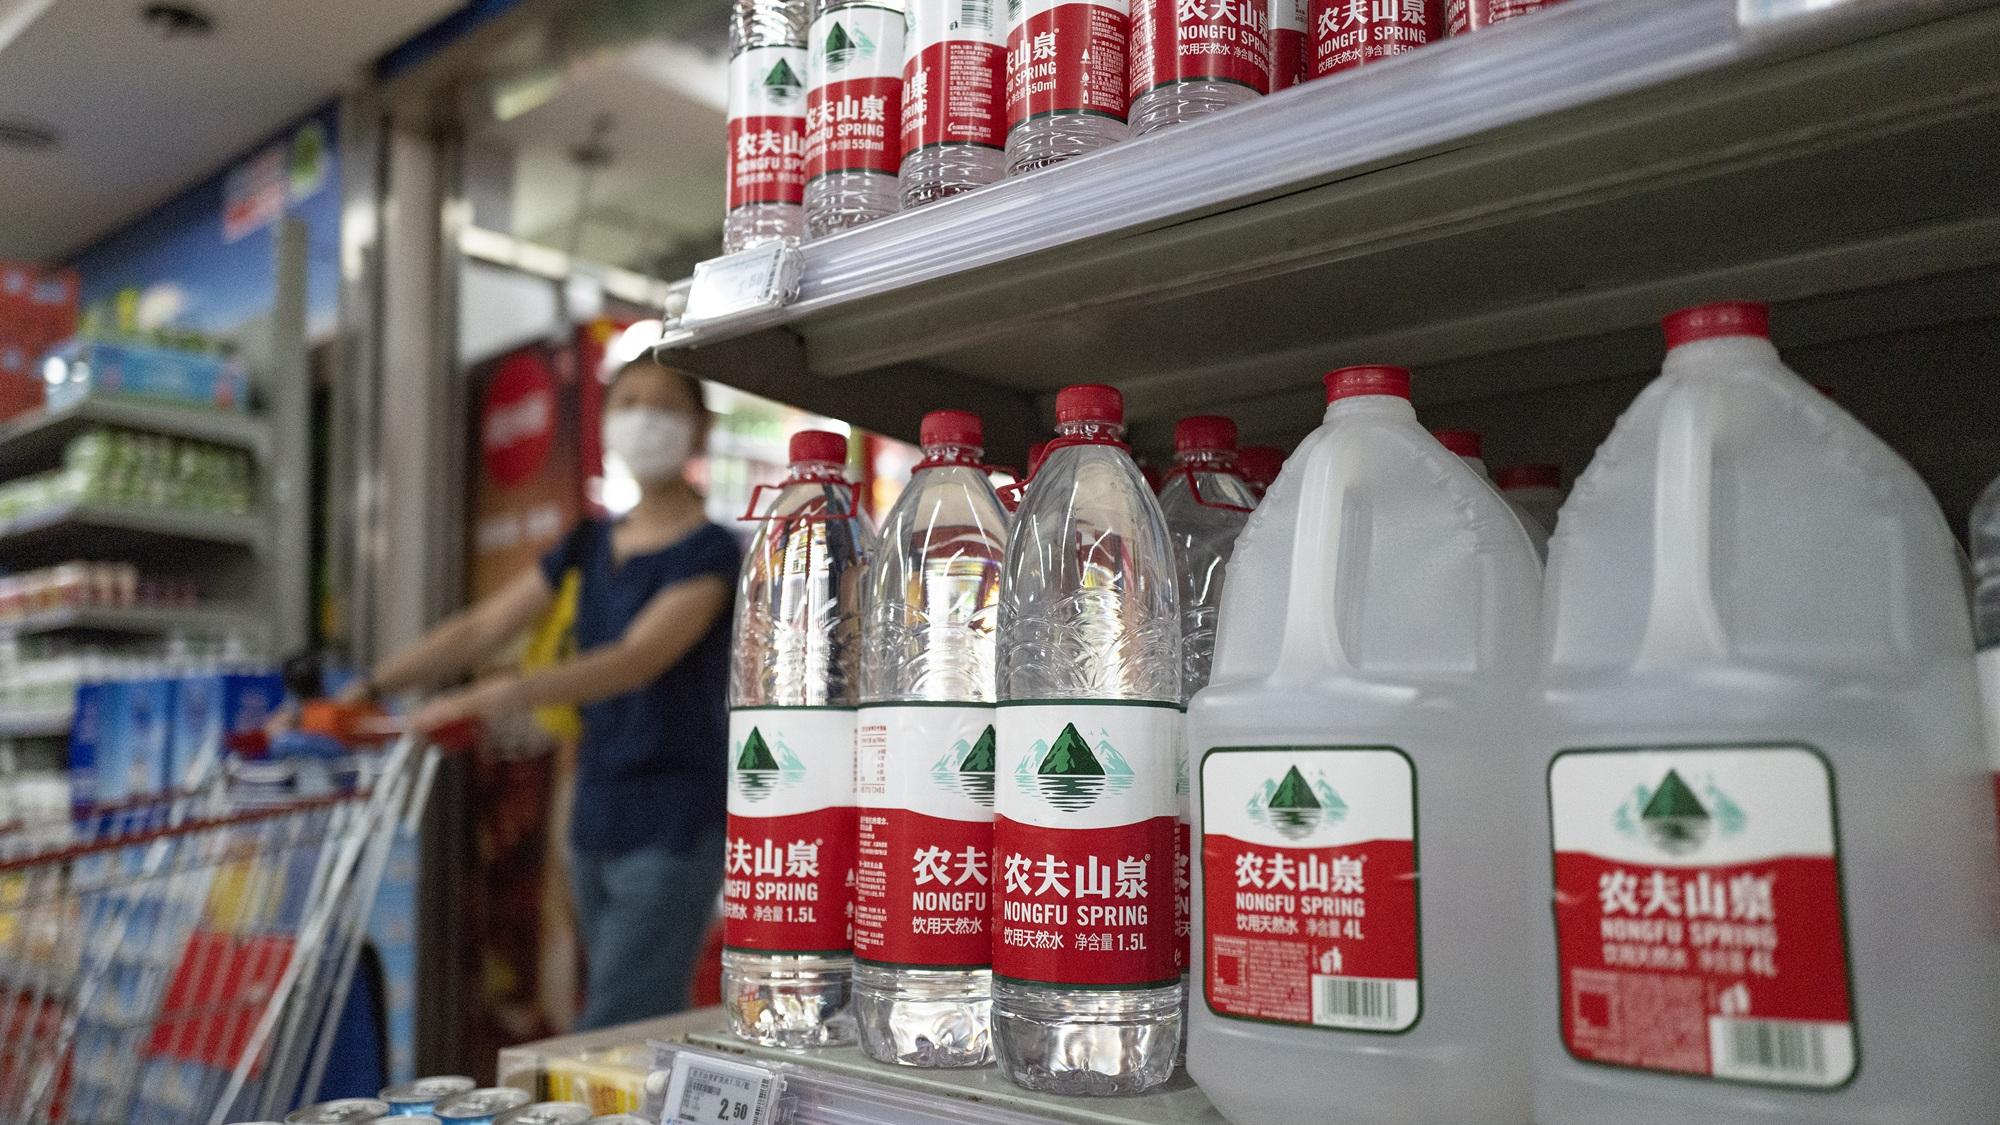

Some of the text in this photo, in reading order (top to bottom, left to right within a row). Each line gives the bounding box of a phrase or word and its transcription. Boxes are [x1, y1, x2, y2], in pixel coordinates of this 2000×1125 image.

[1178, 24, 1236, 41] NONGFU
[1317, 0, 1427, 40] 农夫山泉
[1178, 42, 1231, 56] 饮用天然水
[1318, 28, 1368, 59] NONGFU
[1374, 26, 1427, 44] SPRING
[1015, 61, 1056, 87] SPRING
[1318, 48, 1362, 74] 饮用天然水
[1026, 79, 1056, 96] 550ml
[836, 123, 884, 137] SPRING
[851, 138, 884, 151] 550ml
[912, 845, 988, 886] 农夫
[1003, 852, 1149, 899] 农夫山泉
[1235, 852, 1365, 895] 农夫山泉
[755, 882, 819, 901] SPRING
[912, 891, 986, 912] NONGFU
[786, 906, 817, 923] 1.5L
[1004, 900, 1068, 926] NONGFU
[1076, 905, 1148, 927] SPRING
[1236, 892, 1365, 918] NONGFU SPRING
[912, 916, 983, 934] 饮用天然水
[1236, 913, 1299, 935] 饮用天然水
[1342, 920, 1365, 940] 4L
[1004, 926, 1147, 952] 饮用天然水 净含量 1.5L
[717, 1097, 749, 1121] 2.50
